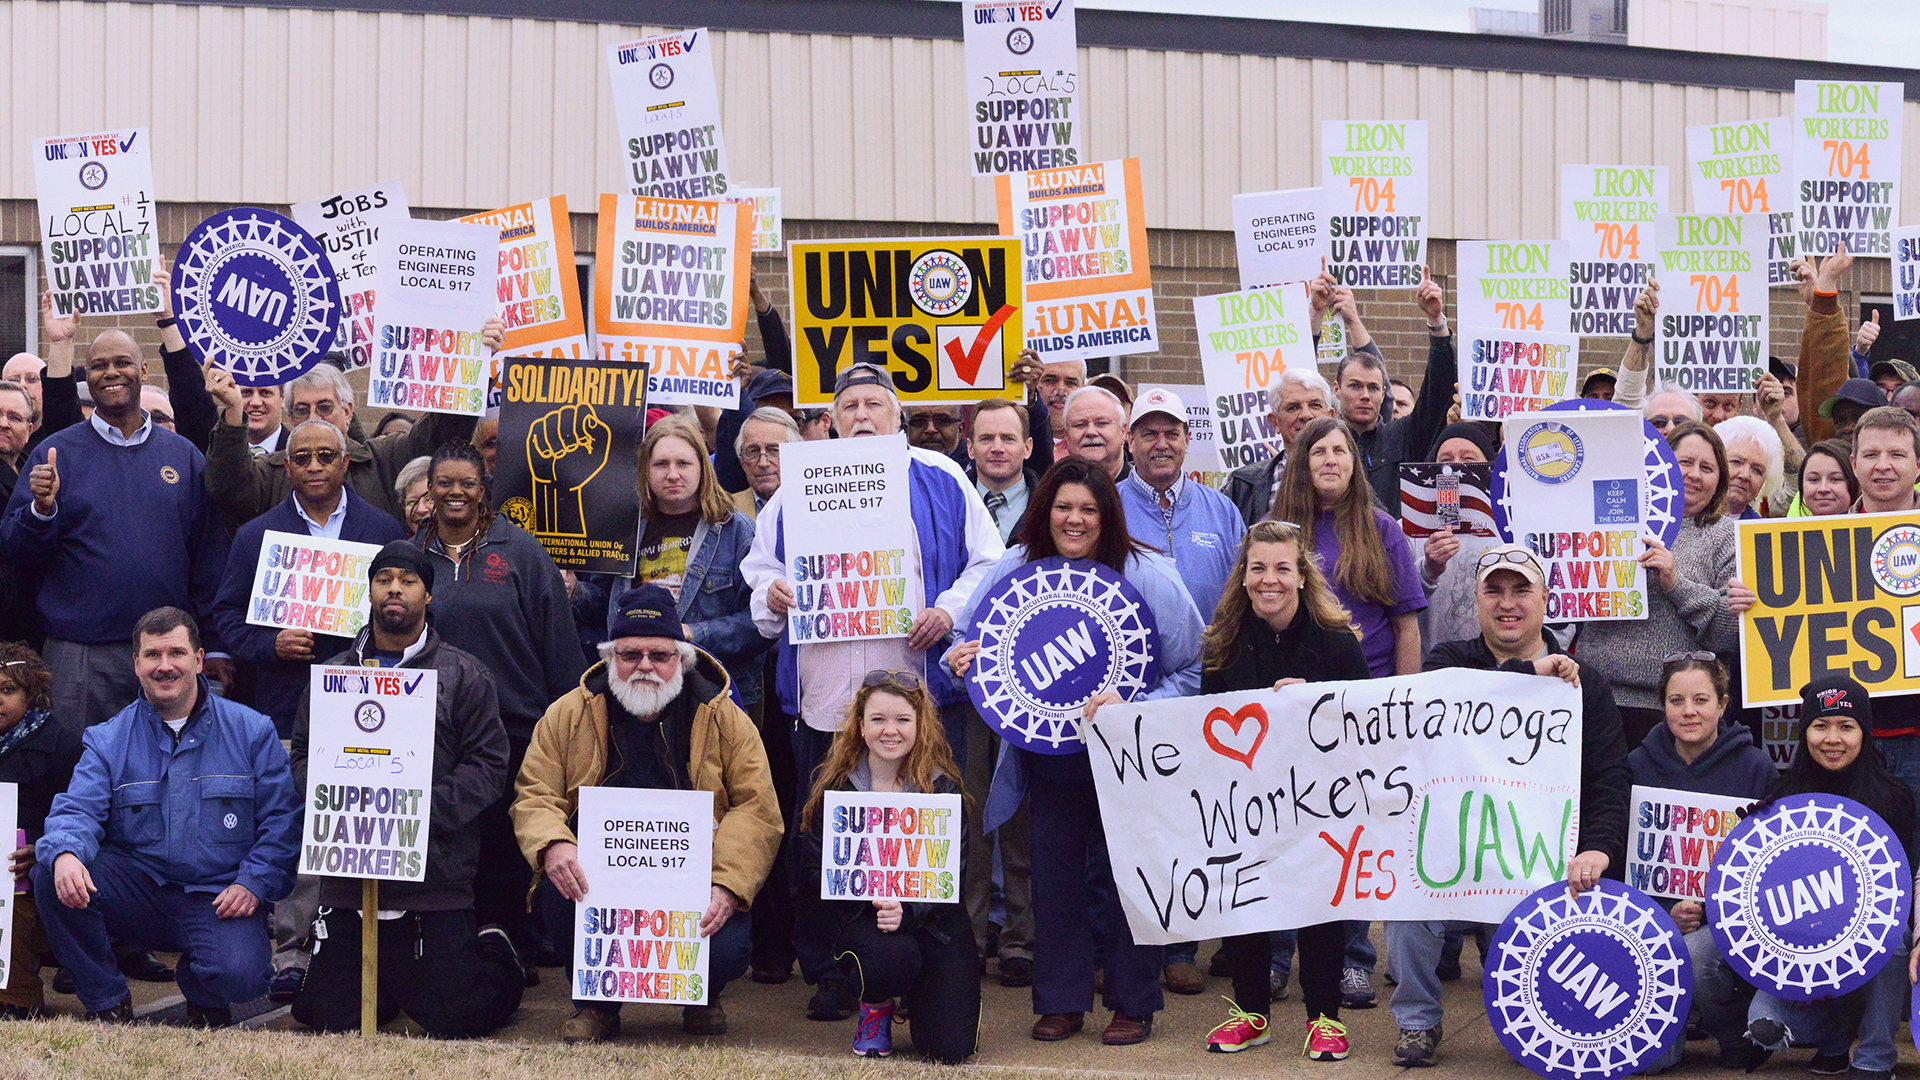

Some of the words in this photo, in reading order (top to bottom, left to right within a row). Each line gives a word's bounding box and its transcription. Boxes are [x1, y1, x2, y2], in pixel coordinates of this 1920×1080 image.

[1020, 6, 1042, 21] YES
[659, 40, 680, 57] YES
[983, 76, 1058, 97] LOCAL
[1816, 84, 1880, 114] IRON
[976, 97, 1072, 123] SUPPORT
[628, 124, 715, 160] SUPPORT
[978, 122, 1072, 149] UAWVW
[1345, 124, 1406, 152] IRON
[1710, 122, 1770, 155] IRON
[1803, 118, 1888, 140] WORKERS
[92, 139, 116, 156] YES
[974, 148, 1078, 174] WORKERS
[1824, 140, 1870, 179] 704
[1028, 167, 1104, 190] LiUNA!
[1328, 156, 1412, 176] WORKERS
[1697, 154, 1781, 180] WORKERS
[1029, 188, 1061, 199] BUILDS
[1062, 184, 1104, 194] AMERICA
[1350, 177, 1396, 213] 704
[1592, 168, 1655, 196] IRON
[1720, 178, 1770, 214] 704
[1800, 180, 1893, 204] SUPPORT
[320, 190, 388, 219] JOBS
[637, 200, 716, 224] LiUNA!
[1021, 199, 1119, 231] SUPPORT
[1573, 202, 1658, 222] WORKERS
[49, 210, 133, 237] LOCAL
[336, 216, 366, 233] with
[635, 220, 670, 231] BUILDS
[671, 222, 716, 234] AMERICA
[1252, 212, 1315, 228] OPERATING
[1254, 224, 1317, 240] ENGINEERS
[1330, 216, 1421, 238] SUPPORT
[1676, 216, 1742, 246] IRON
[51, 233, 150, 264] SUPPORT
[399, 244, 476, 261] OPERATING
[1023, 224, 1120, 257] UAWVW
[1258, 241, 1295, 253] LOCAL
[1297, 238, 1315, 249] 917
[1594, 223, 1640, 260] 704
[1798, 231, 1890, 254] WORKERS
[352, 250, 368, 262] of
[398, 260, 475, 276] ENGINEERS
[622, 240, 726, 270] SUPPORT
[1486, 244, 1550, 274] IRON
[1660, 250, 1750, 272] WORKERS
[54, 259, 152, 290] UAWVW
[400, 276, 446, 290] LOCAL
[449, 280, 470, 292] 917
[622, 267, 726, 299] UAWVW
[805, 248, 1006, 320] UNION
[930, 278, 950, 289] UAW
[1328, 264, 1422, 286] WORKERS
[54, 286, 159, 315] WORKERS
[216, 272, 288, 327] UAW
[1479, 278, 1569, 300] WORKERS
[1690, 274, 1740, 313] 704
[615, 295, 728, 326] WORKERS
[1216, 289, 1284, 326] IRON
[1495, 302, 1544, 330] 704
[380, 324, 483, 356] SUPPORT
[1078, 327, 1152, 348] AMERICA
[1208, 322, 1298, 354] WORKERS
[1662, 315, 1762, 338] SUPPORT
[803, 324, 932, 394] YES
[1472, 339, 1570, 368] SUPPORT
[1236, 348, 1287, 390] 704
[374, 380, 482, 412] WORKERS
[508, 364, 644, 407] SOLIDARITY!
[660, 378, 734, 398] AMERICA
[1196, 432, 1214, 440] 917
[804, 463, 885, 479] OPERATING
[805, 480, 886, 496] ENGINEERS
[809, 498, 856, 512] LOCAL
[860, 497, 883, 508] 917
[536, 538, 587, 548] INTERNATIONAL
[590, 540, 612, 548] UNION
[577, 549, 600, 557] ALLIED
[1525, 531, 1637, 558] SUPPORT
[267, 544, 372, 580] SUPPORT
[794, 549, 904, 582] SUPPORT
[1894, 554, 1917, 567] UAW
[1016, 593, 1060, 618] AGRICULTURAL
[1063, 592, 1100, 610] IMPLEMENT
[254, 597, 364, 634] WORKERS
[792, 608, 913, 640] WORKERS
[1006, 619, 1016, 634] AND
[1100, 610, 1121, 640] WORKERS
[1020, 620, 1097, 690] UAW
[1118, 643, 1123, 652] OF
[1753, 607, 1897, 690] YES
[1110, 656, 1121, 686] AMERICA
[374, 677, 400, 695] YES
[1816, 688, 1838, 698] UNION
[1038, 710, 1064, 718] UNITED
[1094, 714, 1181, 785] We
[1307, 687, 1572, 766] Chattanooga
[314, 784, 422, 815] SUPPORT
[1192, 765, 1414, 849] Workers
[313, 814, 420, 848] UAWVW
[604, 820, 690, 833] OPERATING
[832, 806, 952, 835] SUPPORT
[604, 838, 690, 850] ENGINEERS
[833, 837, 950, 868] UAWVW
[1774, 830, 1826, 846] AGRICULTURAL
[1828, 833, 1862, 859] IMPLEMENT
[306, 845, 421, 877] WORKERS
[608, 856, 657, 868] LOCAL
[662, 856, 686, 868] 917
[1136, 852, 1270, 933] VOTE
[1318, 824, 1396, 906] YES
[1416, 790, 1572, 890] UAW
[826, 869, 954, 899] WORKERS
[1765, 865, 1844, 926] UAW
[584, 906, 701, 938] SUPPORT
[1522, 978, 1530, 1004] UNITED
[1552, 916, 1592, 932] AEROSPACE
[1614, 924, 1649, 966] AGRICULTURAL
[578, 969, 704, 1002] WORKERS
[1548, 943, 1630, 1019] UAW
